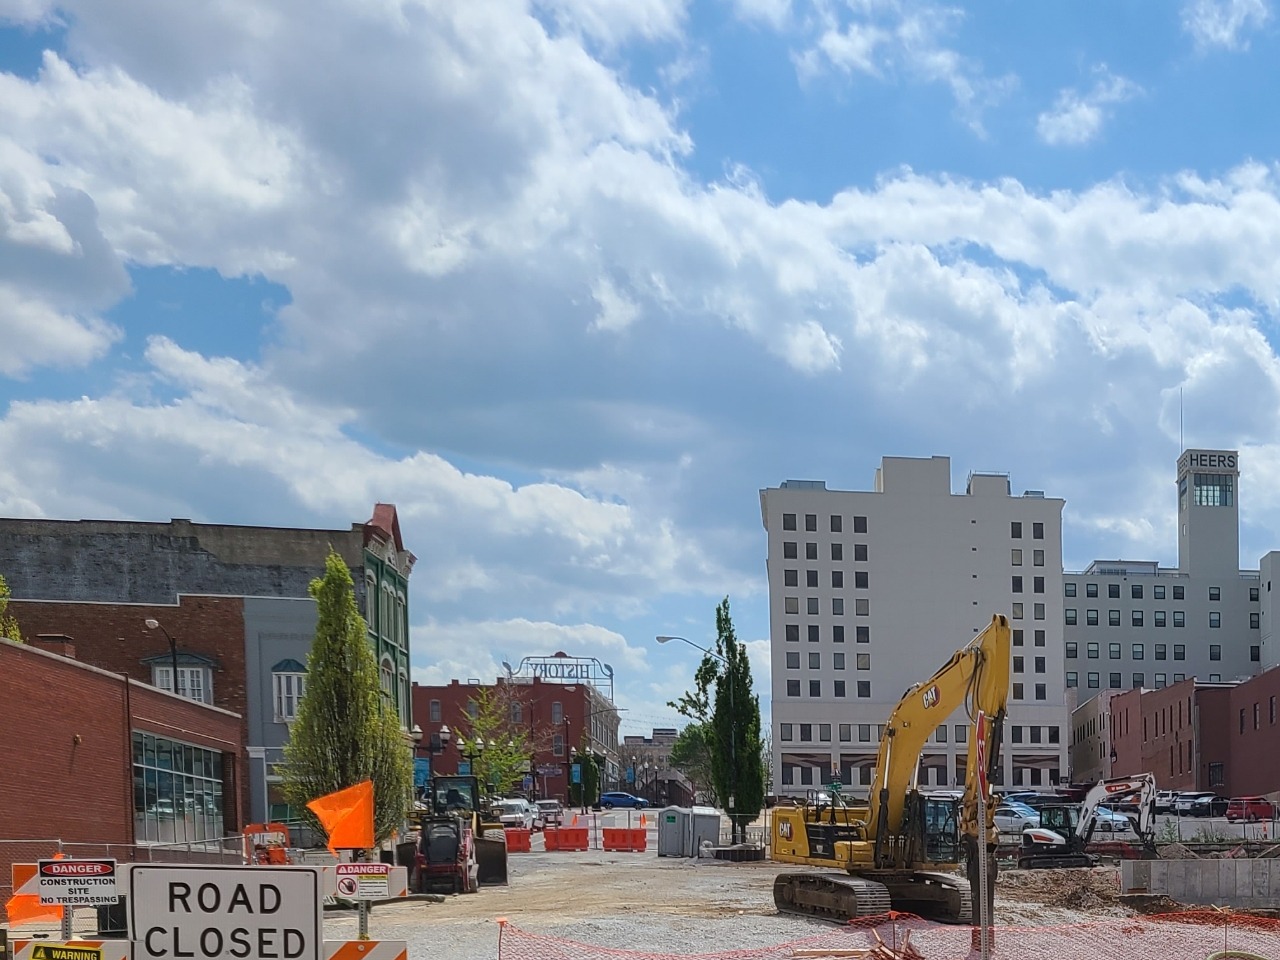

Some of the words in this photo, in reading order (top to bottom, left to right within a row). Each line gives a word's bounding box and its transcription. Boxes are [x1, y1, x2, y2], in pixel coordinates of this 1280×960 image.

[1190, 453, 1236, 468] HEERS
[922, 685, 937, 709] CAT
[780, 822, 791, 838] CAT
[52, 865, 102, 873] DANGER
[40, 878, 116, 886] CONSTRUCTION
[68, 887, 90, 895] SITE
[168, 882, 282, 914] ROAD
[56, 896, 118, 904] TRESPASSING
[145, 926, 305, 959] CLOSED
